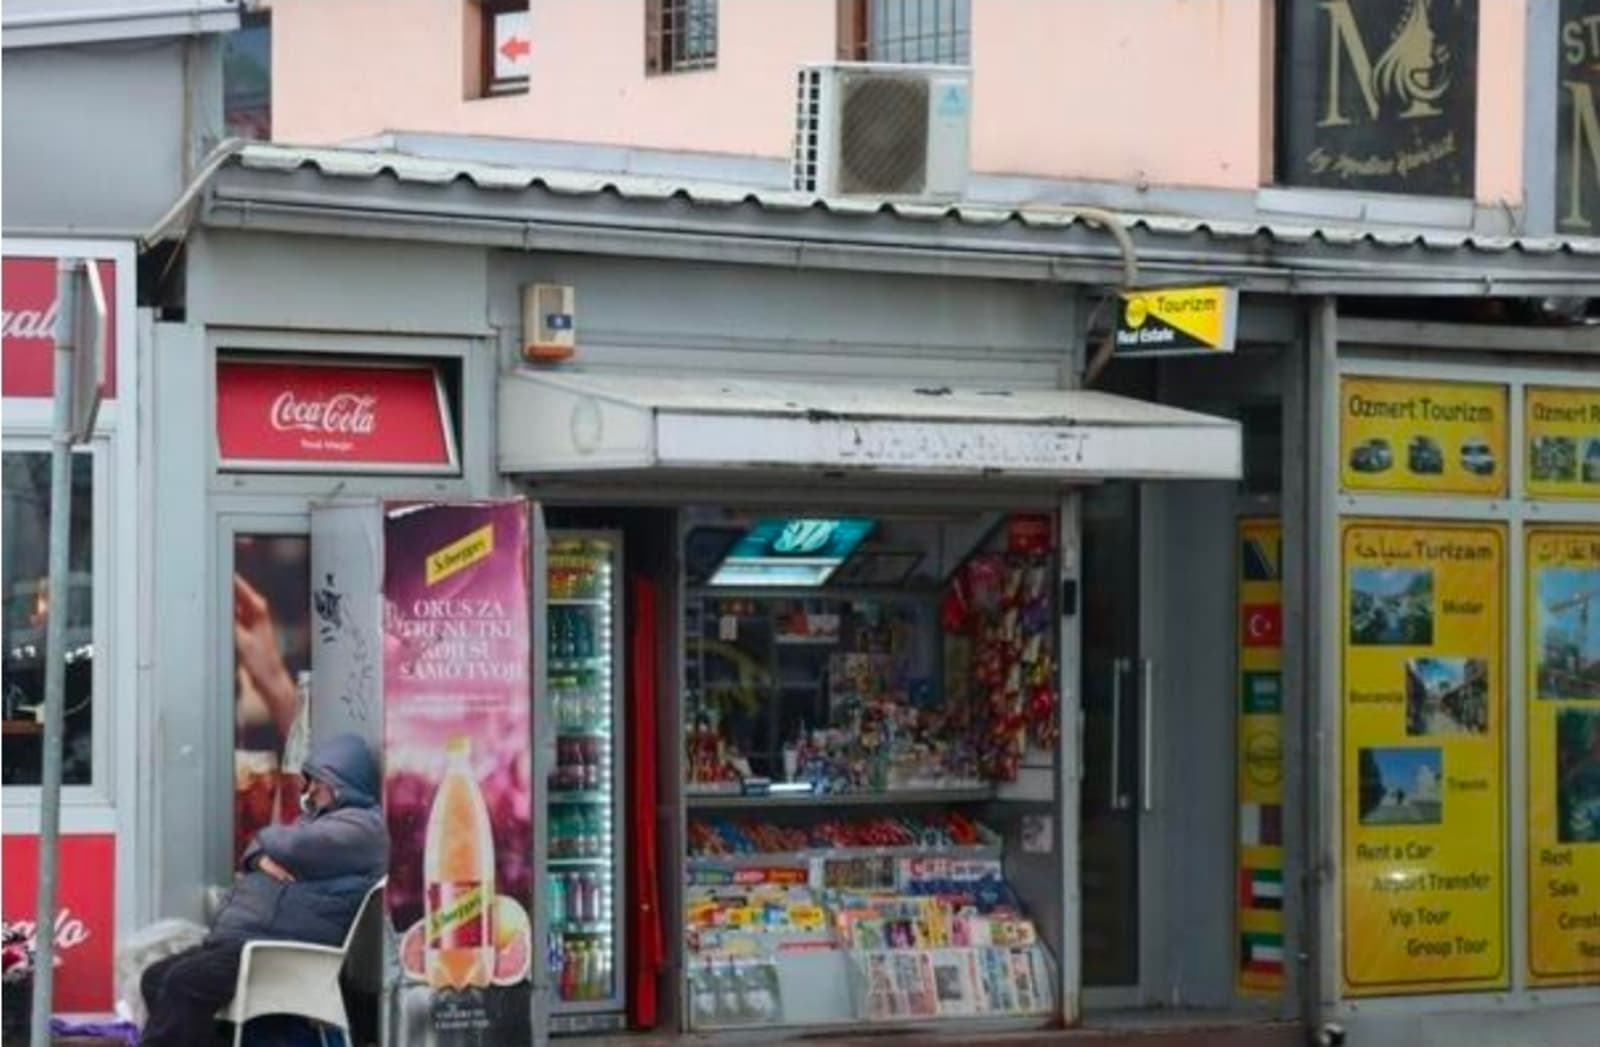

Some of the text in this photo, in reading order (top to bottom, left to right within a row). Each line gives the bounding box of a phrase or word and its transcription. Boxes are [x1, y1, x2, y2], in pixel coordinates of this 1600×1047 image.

[1563, 14, 1600, 64] ST
[1157, 296, 1217, 313] Tourizm
[270, 391, 377, 433] Coca-Cola
[1349, 394, 1495, 424] Ozmert Tourizm
